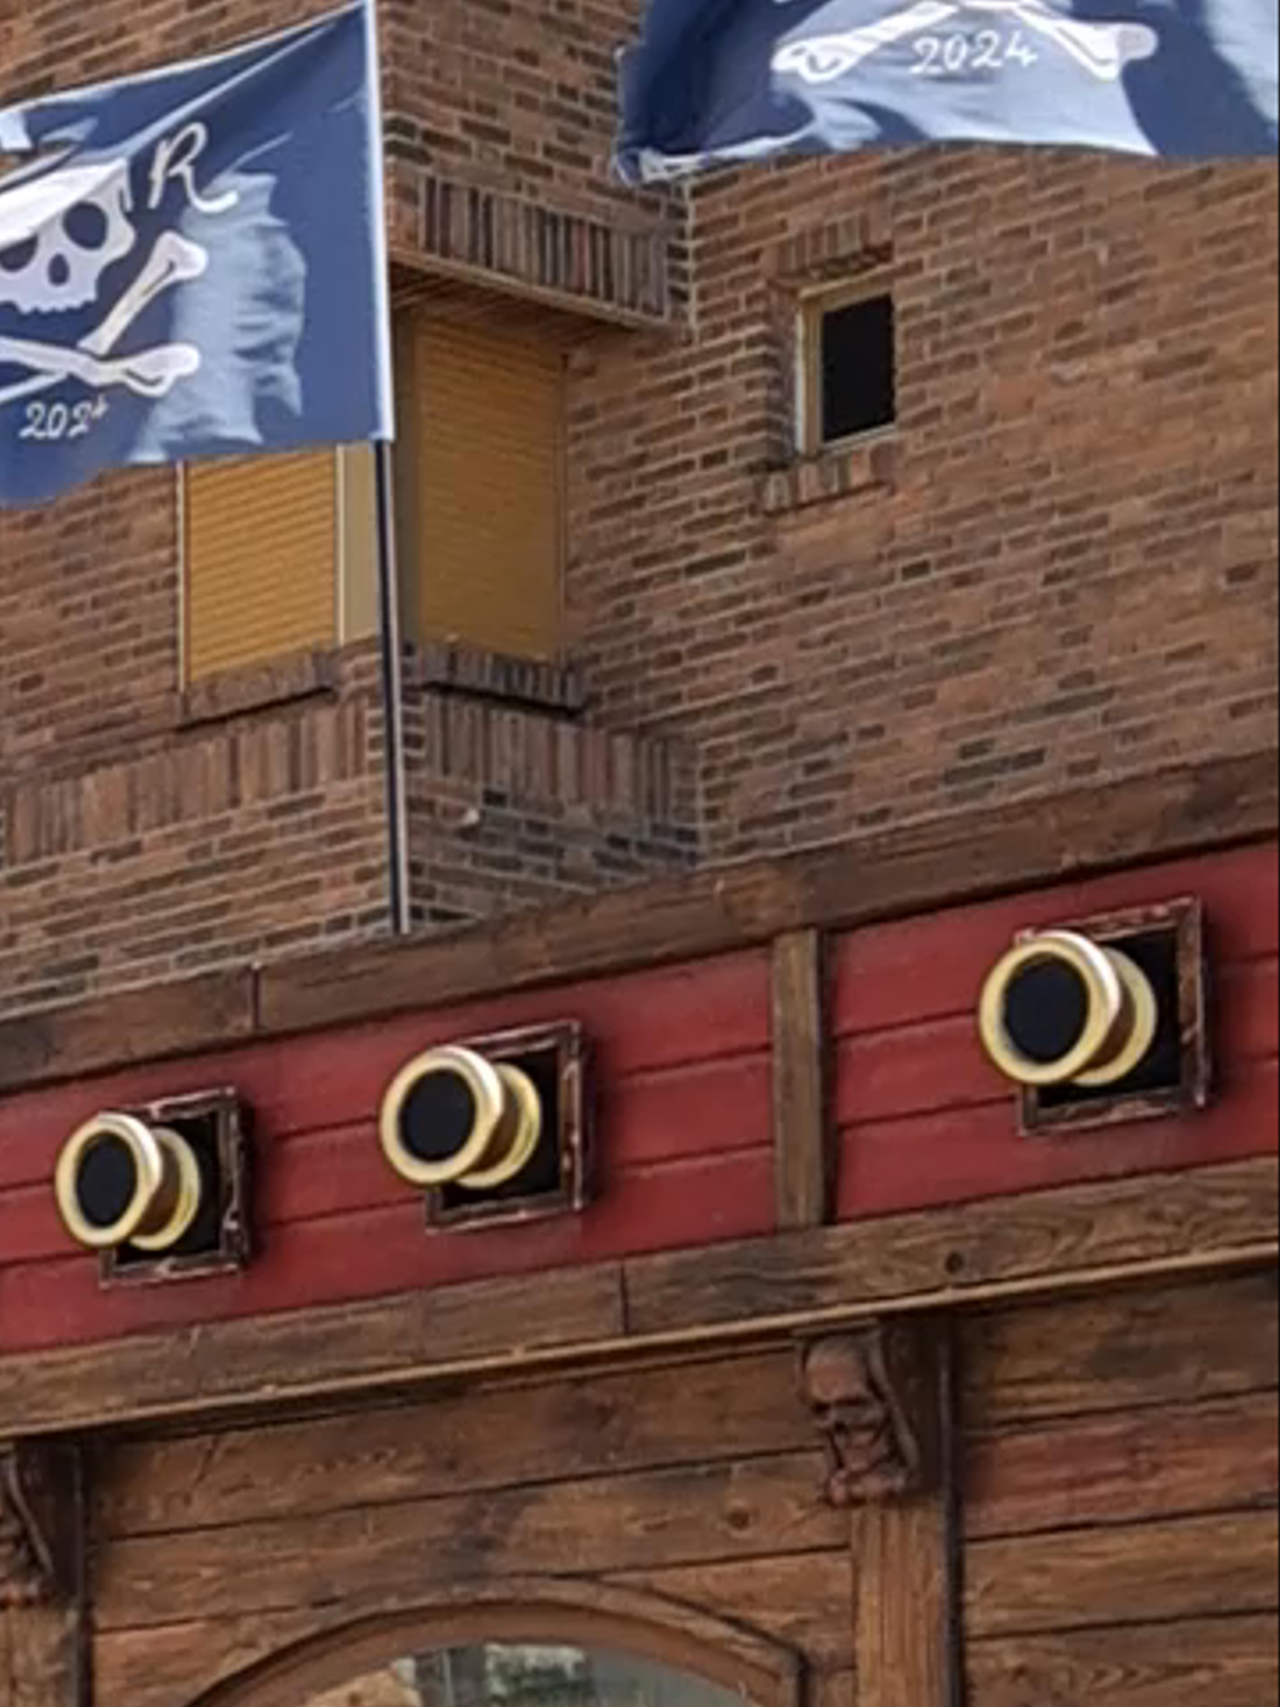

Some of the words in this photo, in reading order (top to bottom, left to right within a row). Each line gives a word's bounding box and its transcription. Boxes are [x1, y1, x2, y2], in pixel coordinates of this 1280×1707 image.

[910, 28, 1038, 76] 2024
[148, 121, 240, 213] R
[19, 394, 109, 441] 2024
